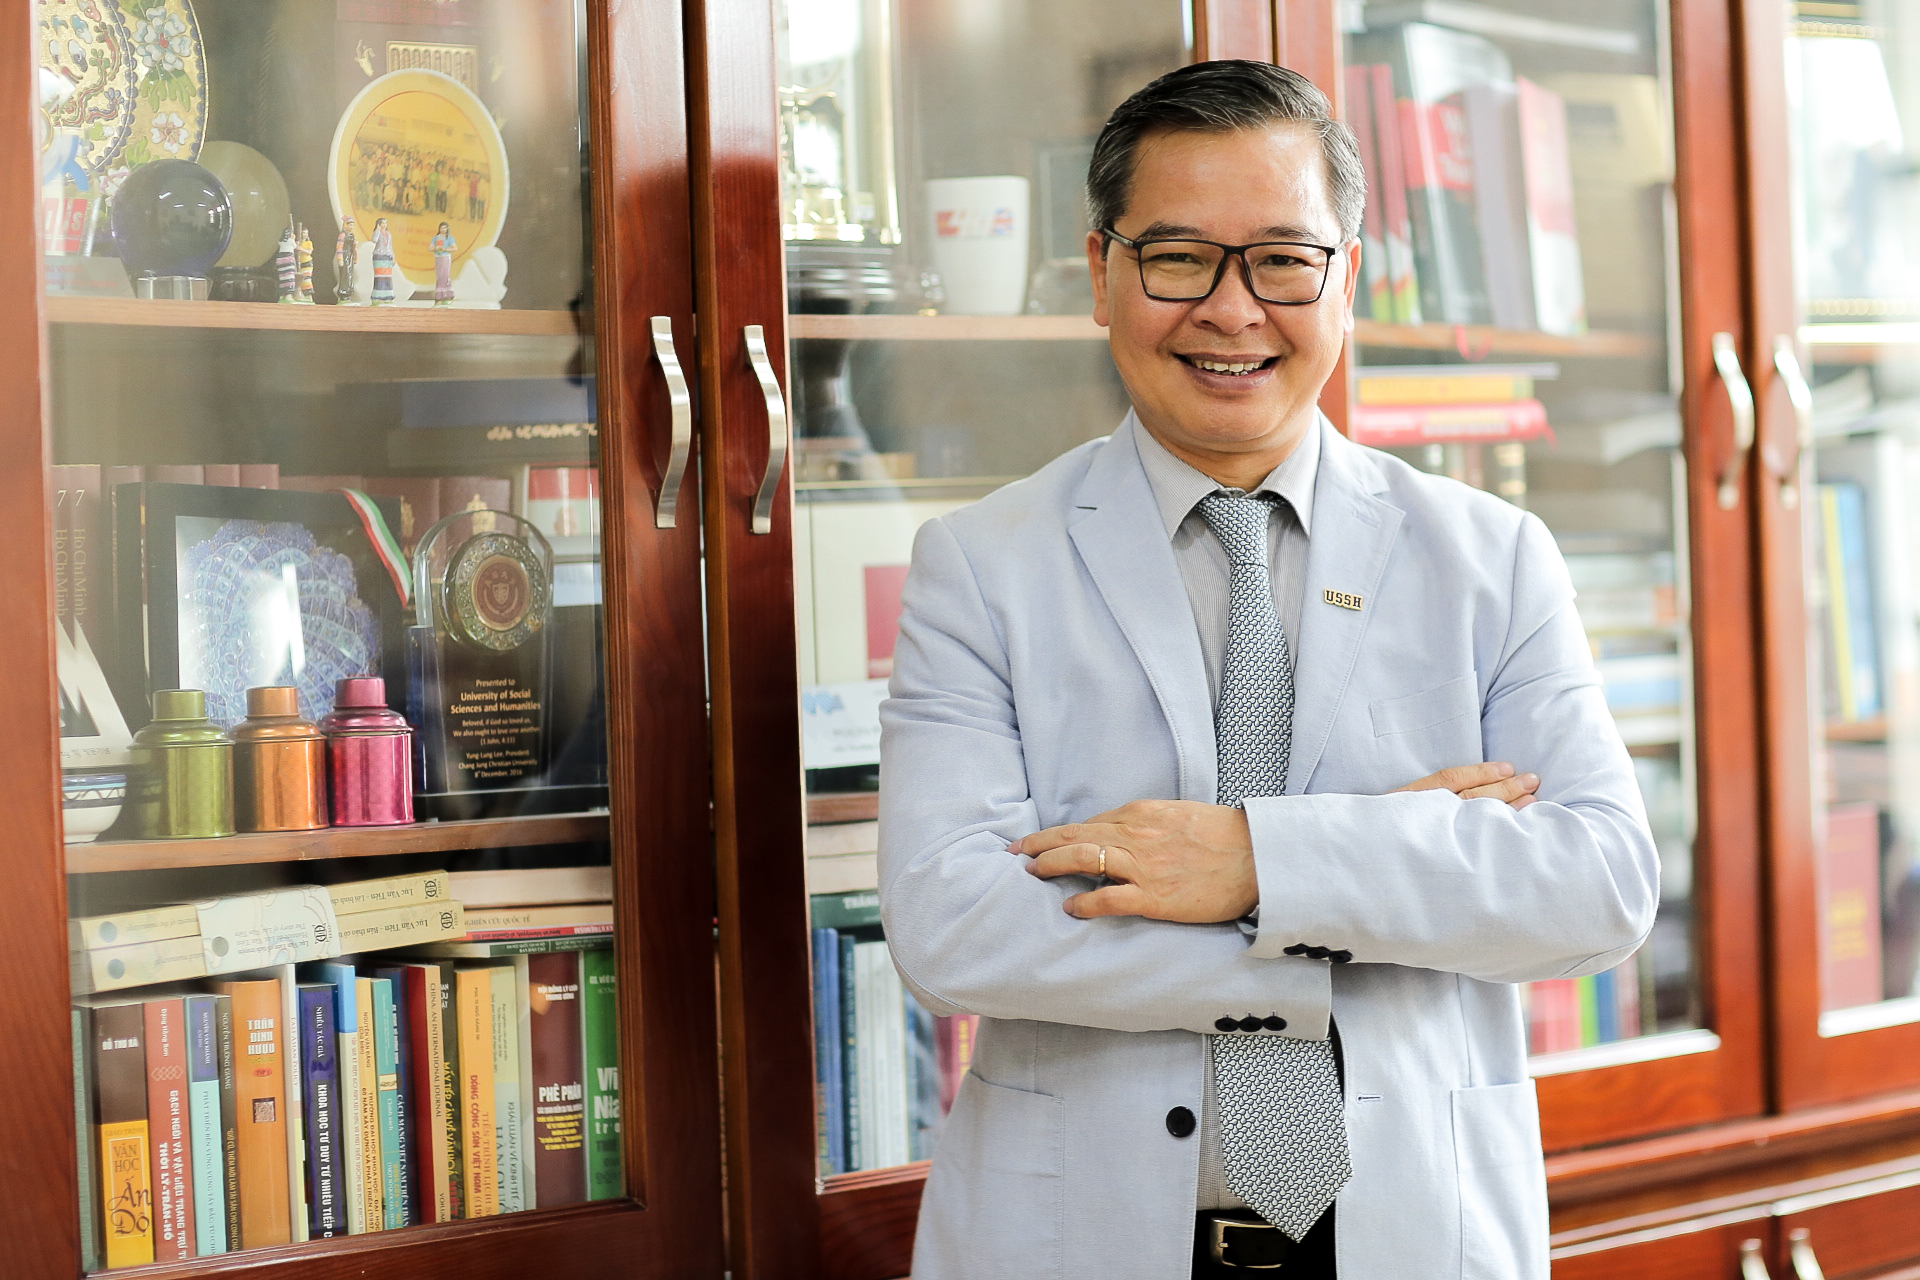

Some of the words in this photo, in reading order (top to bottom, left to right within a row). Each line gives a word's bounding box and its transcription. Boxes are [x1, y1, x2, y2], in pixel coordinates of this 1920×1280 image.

[58, 490, 67, 507] 7
[76, 489, 85, 506] 7
[56, 578, 69, 616] Minh
[74, 578, 87, 616] Minh
[1325, 589, 1362, 609] USSH
[476, 679, 507, 687] Presented
[461, 691, 498, 701] University
[500, 690, 508, 699] of
[510, 689, 531, 699] Social
[451, 704, 482, 714] Sciences
[484, 702, 498, 712] and
[500, 701, 541, 711] Humanities
[462, 719, 484, 727] Beloved,
[475, 728, 489, 736] ought
[458, 762, 474, 770] Chang
[415, 918, 428, 927] Lục
[431, 1011, 437, 1022] AN
[222, 1013, 230, 1039] NGUYỄN
[316, 1030, 324, 1044] TÁC
[432, 1024, 440, 1082] INTERNATIONAL
[444, 1062, 455, 1081] MẤY
[470, 1074, 480, 1100] ĐẢNG
[538, 1083, 561, 1102] PHÊ
[169, 1091, 179, 1116] GẠCH
[203, 1091, 211, 1109] PHÁT
[317, 1084, 327, 1109] KHOA
[434, 1084, 442, 1118] JOURNAL
[368, 1092, 376, 1123] TRƯỜNG
[397, 1094, 405, 1118] CÁCH
[204, 1112, 212, 1132] TRIỂN
[316, 1111, 328, 1129] HỌC
[470, 1103, 481, 1128] CỘNG
[362, 1088, 367, 1096] 60
[365, 1154, 371, 1164] VÀ
[205, 1134, 213, 1147] BỀN
[319, 1131, 330, 1144] TƯ
[369, 1139, 377, 1154] HỌC
[159, 1143, 170, 1169] THỜI
[173, 1142, 183, 1154] VÀ
[320, 1145, 330, 1163] DUY
[483, 1138, 492, 1172] TRÌNH
[114, 1157, 139, 1175] HỌC
[172, 1157, 184, 1175] VẬT
[227, 1151, 236, 1166] THÊM
[472, 1151, 482, 1169] VIỆT
[400, 1165, 408, 1183] NAM
[474, 1172, 482, 1193] NAM
[107, 1175, 152, 1211] Ấn
[173, 1177, 185, 1197] LIỆU
[229, 1191, 237, 1200] TÀI
[321, 1179, 333, 1205] NHIỀU
[208, 1193, 216, 1207] TÂY
[175, 1199, 186, 1228] TRANG
[230, 1212, 238, 1223] CHO
[110, 1209, 150, 1238] Độ
